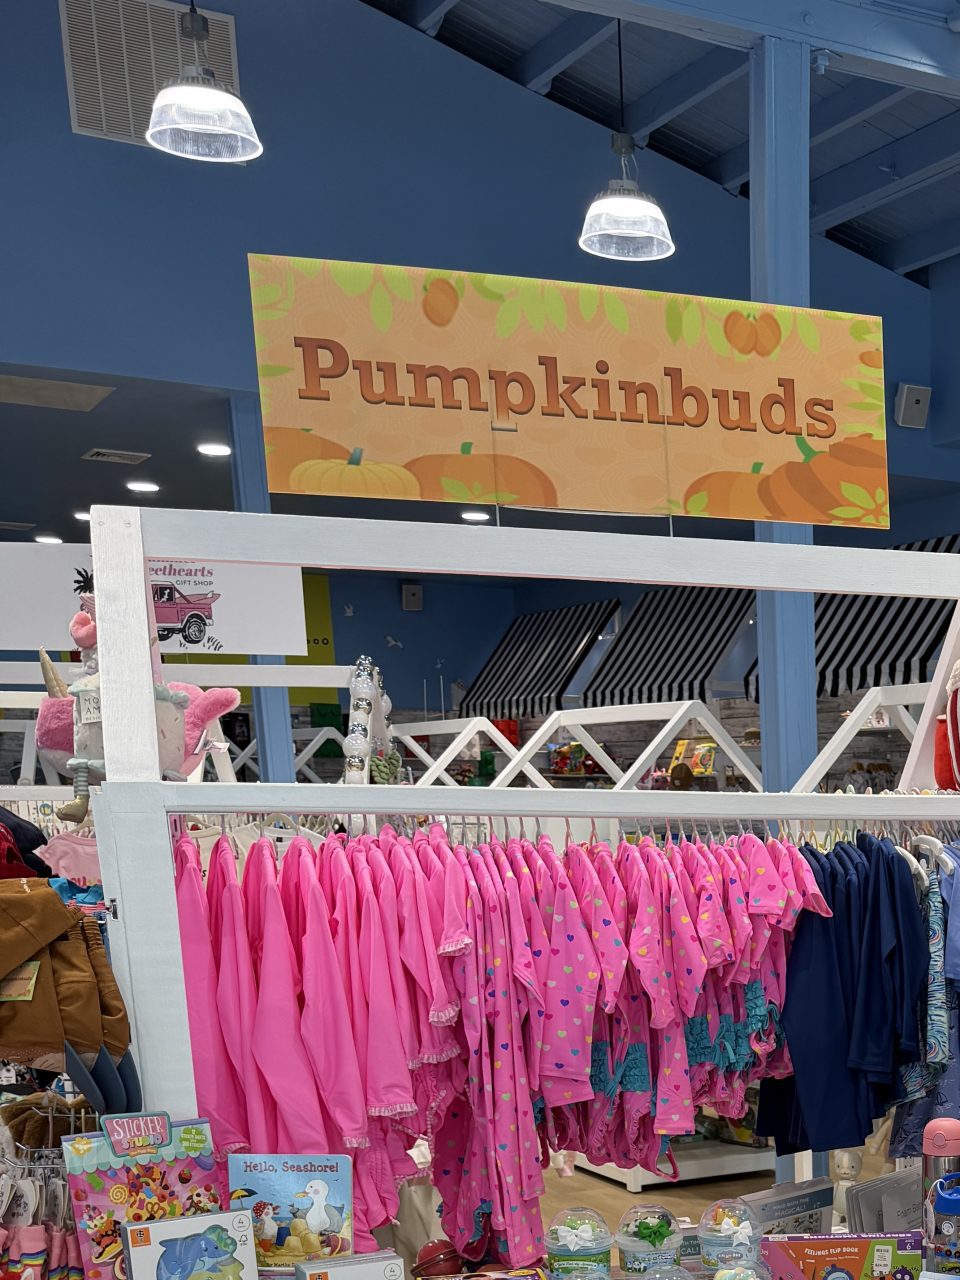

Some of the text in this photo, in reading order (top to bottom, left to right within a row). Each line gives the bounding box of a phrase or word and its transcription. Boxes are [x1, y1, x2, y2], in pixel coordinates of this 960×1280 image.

[293, 336, 838, 440] Pumpkinbuds
[175, 579, 191, 587] GIFT
[112, 1116, 163, 1140] STICKER
[121, 1134, 163, 1150] STUDIO
[243, 1161, 339, 1174] Hello, Seashore!
[804, 1248, 828, 1256] FEELINGS
[830, 1247, 841, 1255] FLIP
